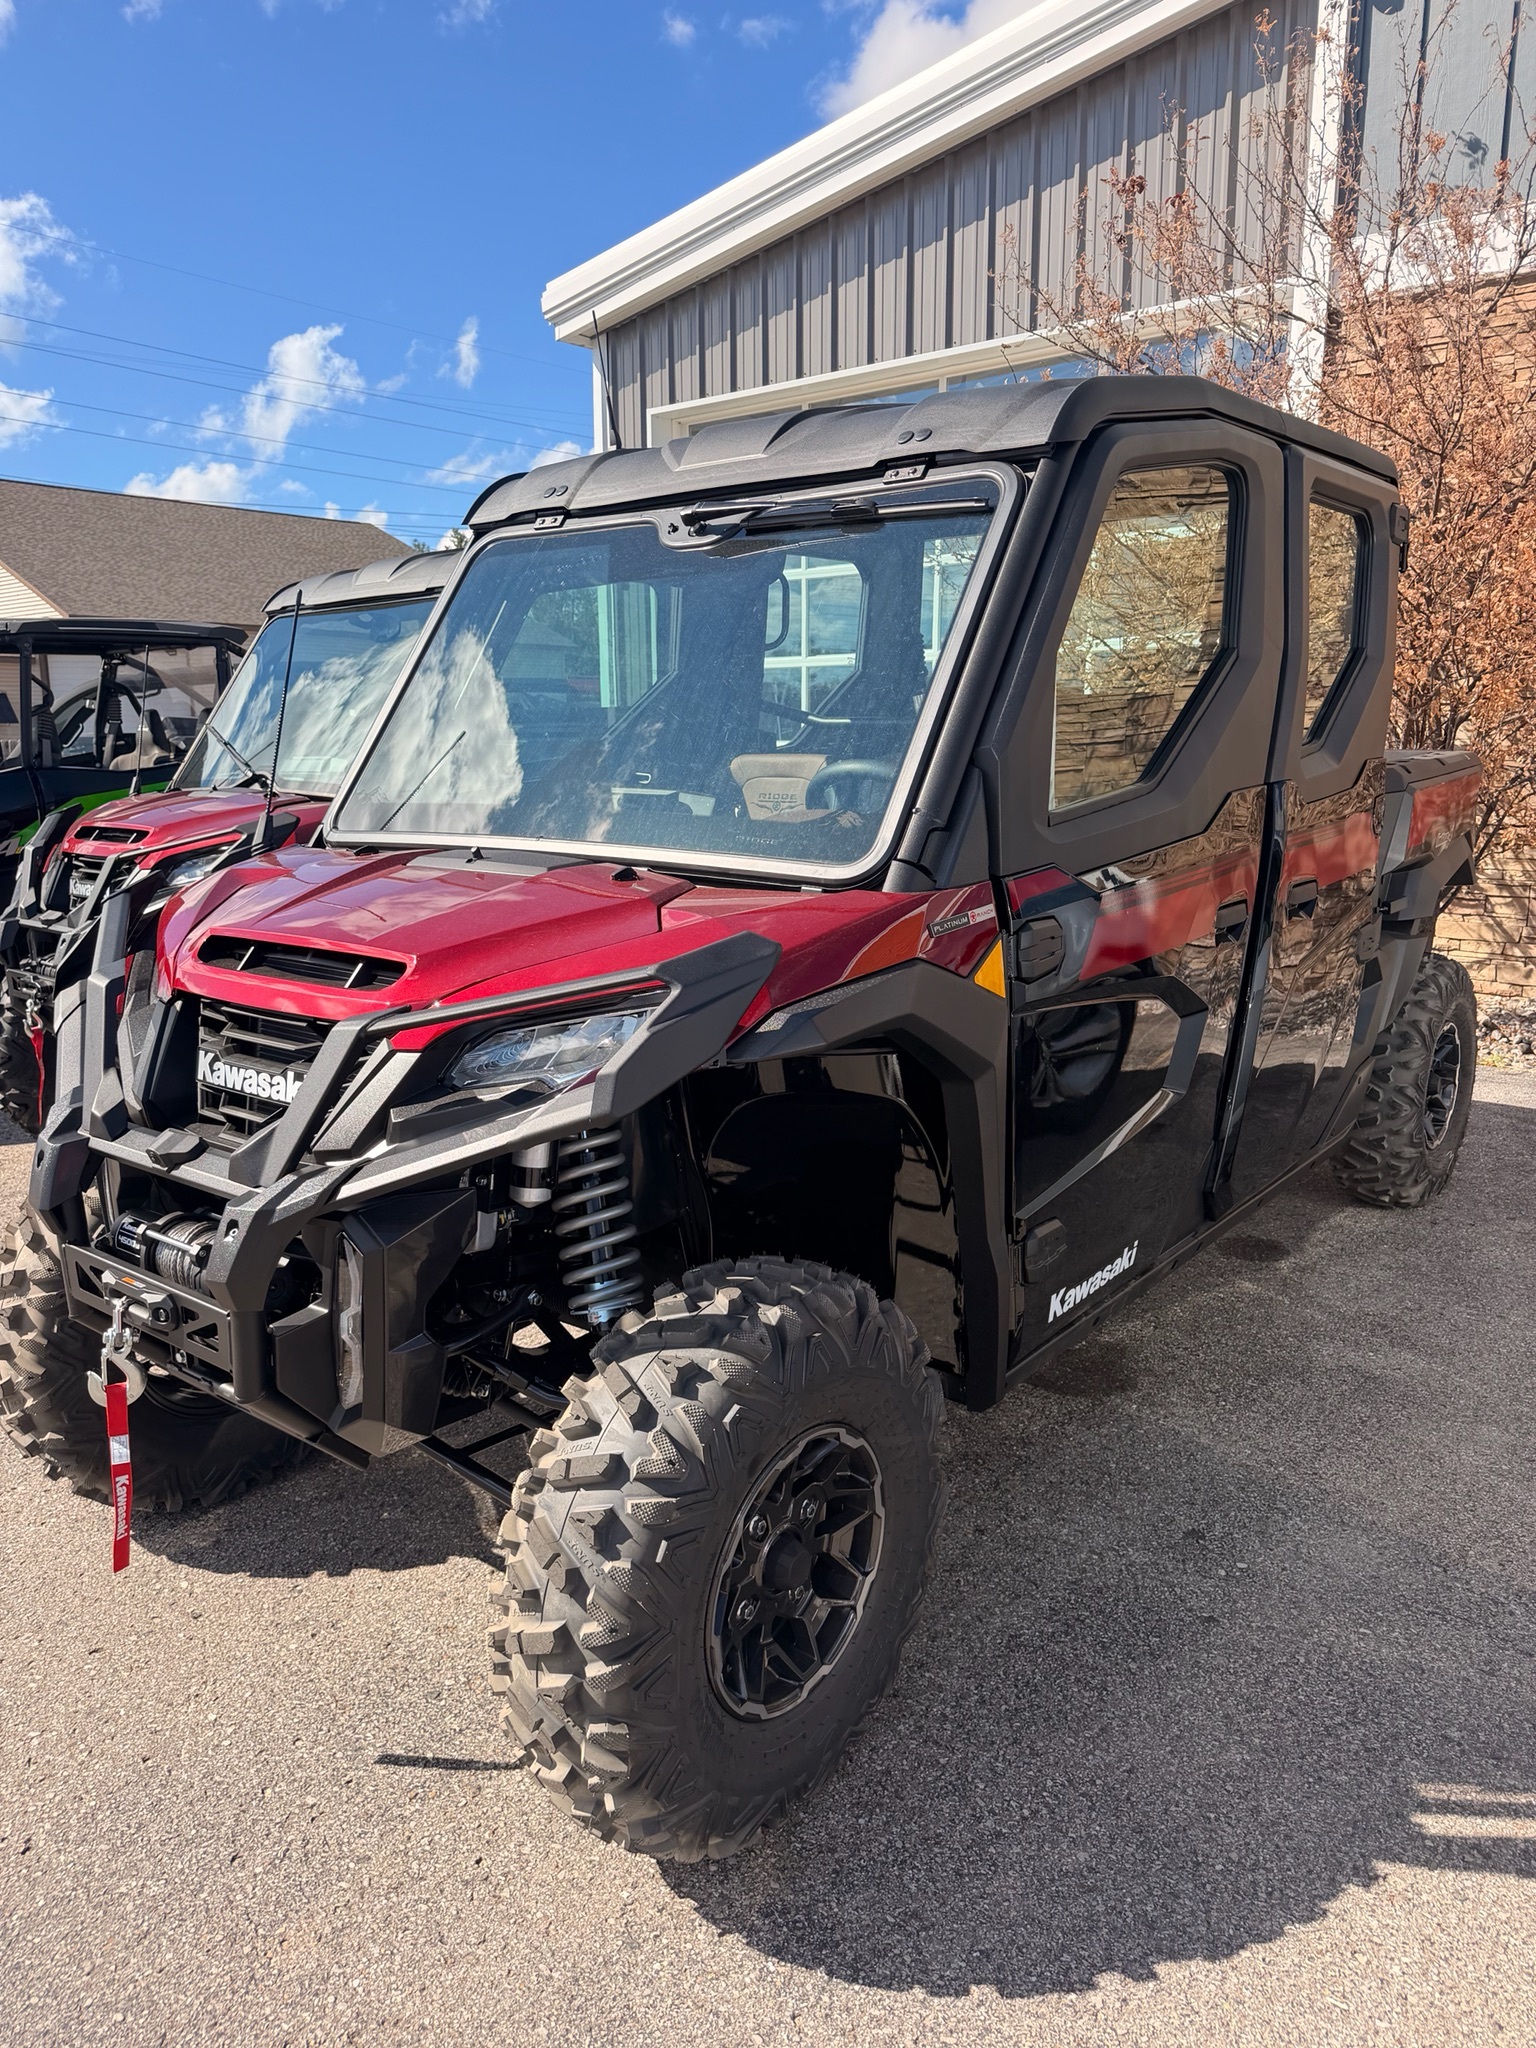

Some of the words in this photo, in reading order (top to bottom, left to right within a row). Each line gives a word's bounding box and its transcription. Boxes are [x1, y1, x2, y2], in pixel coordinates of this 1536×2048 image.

[758, 792, 798, 800] RIDGE
[70, 879, 95, 897] Kawa
[933, 915, 969, 933] PLATINUM
[198, 1050, 307, 1104] Kawasak
[1047, 1240, 1139, 1324] Kawasaki
[115, 1474, 129, 1541] Kawasaki
